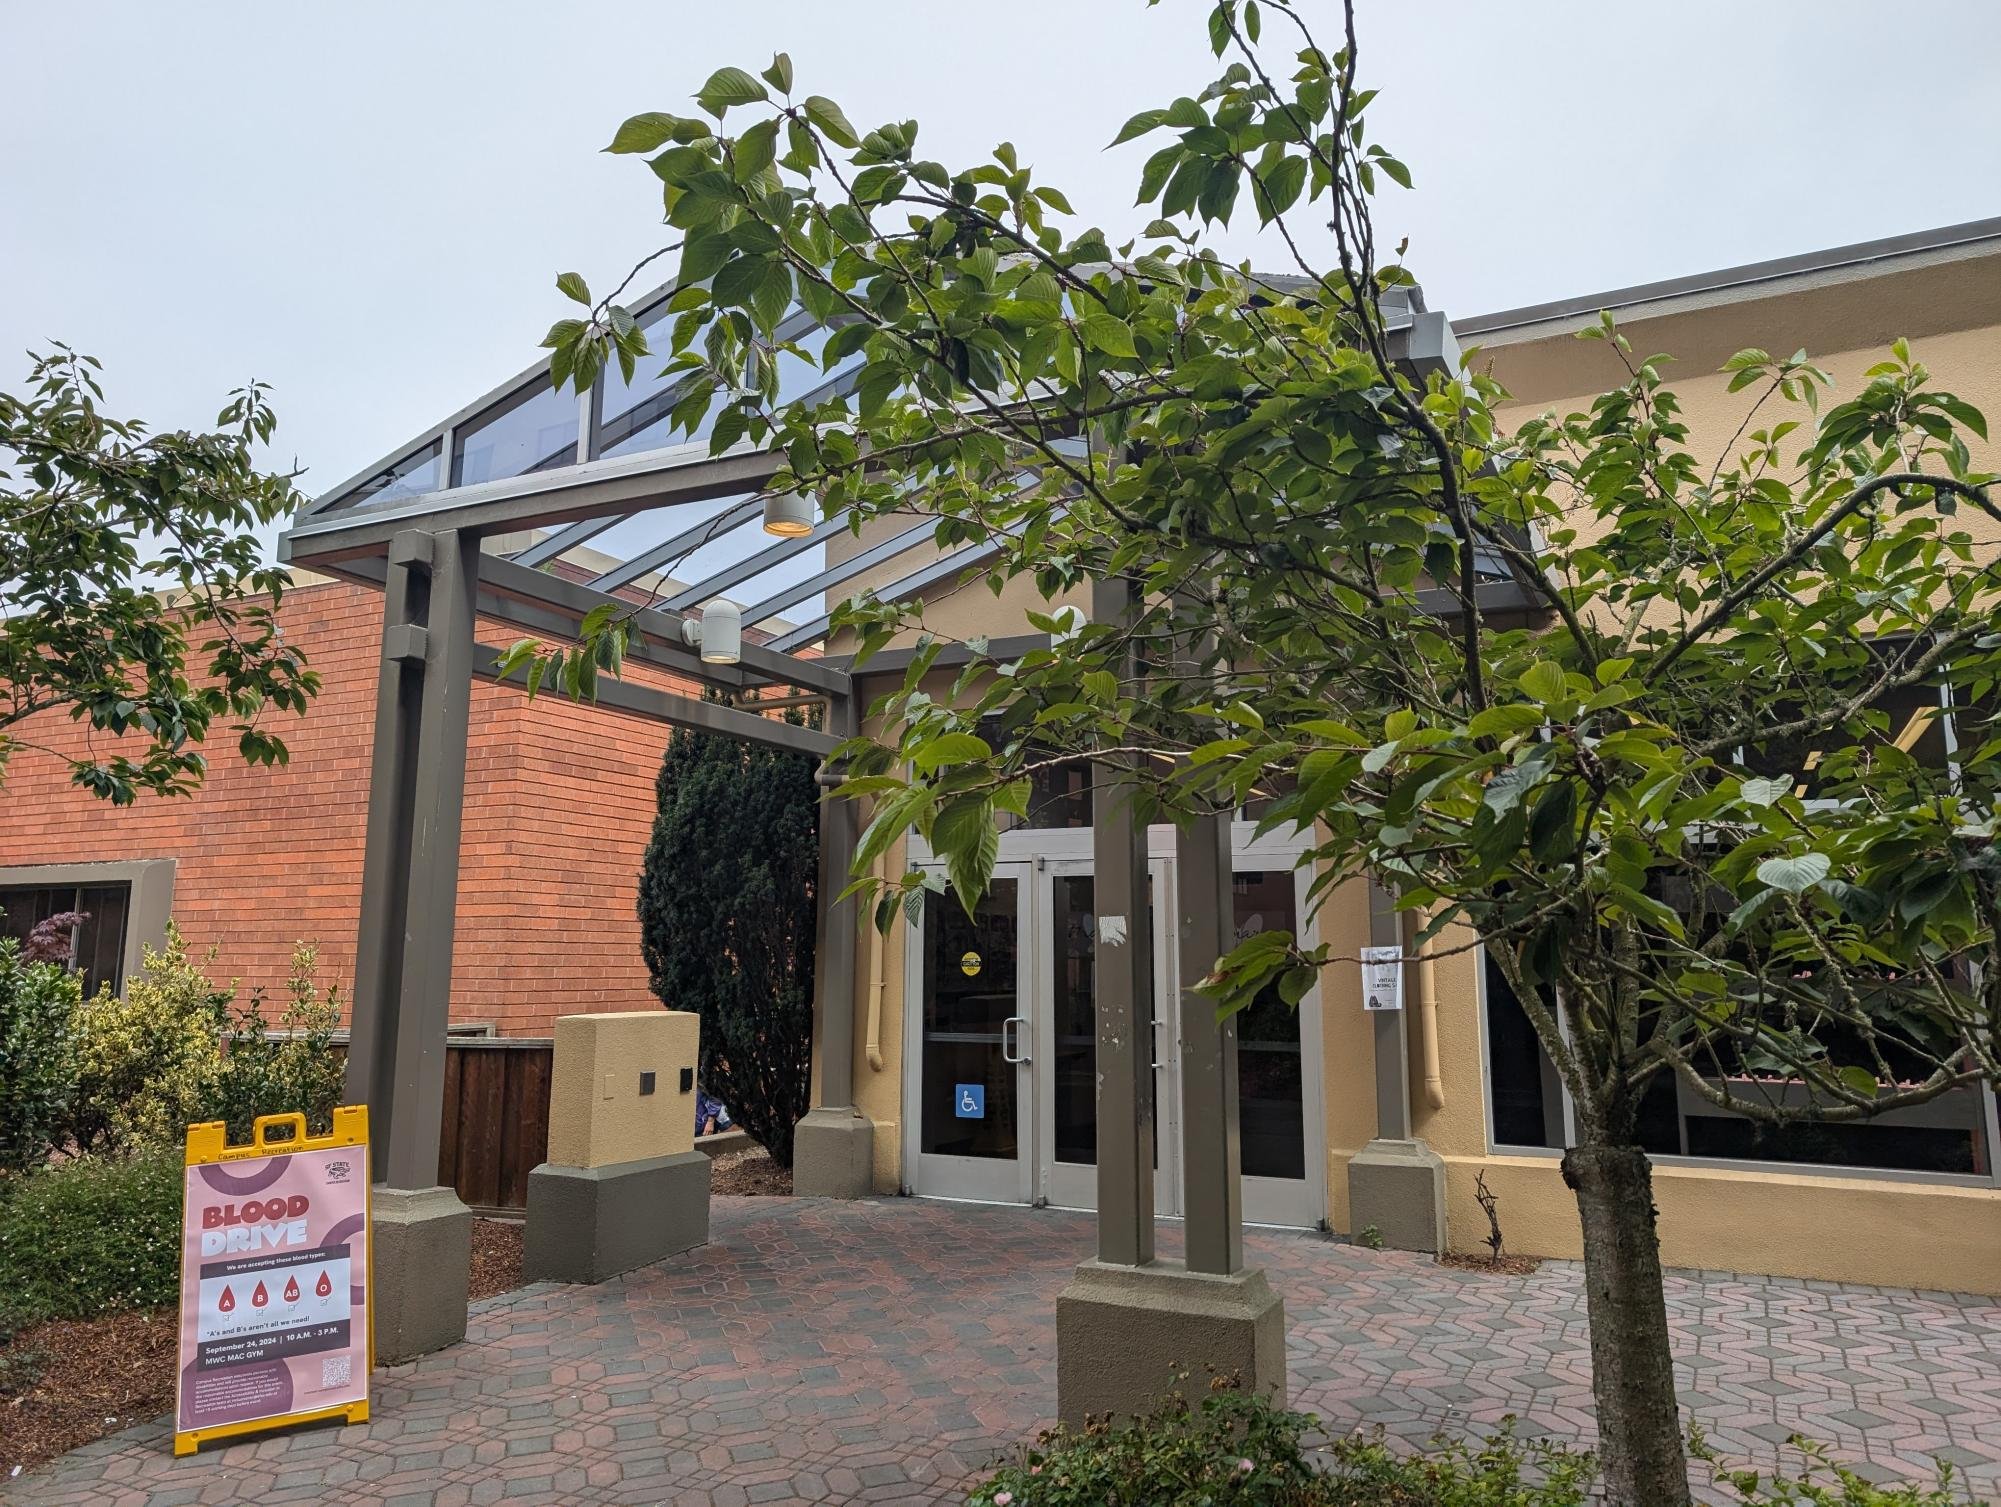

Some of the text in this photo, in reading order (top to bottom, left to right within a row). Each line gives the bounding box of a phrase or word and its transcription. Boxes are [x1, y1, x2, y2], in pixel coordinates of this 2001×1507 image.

[202, 1195, 309, 1229] BLOOD
[201, 1219, 308, 1257] DRIVE
[248, 1259, 275, 1268] accepting
[309, 1252, 326, 1260] types:
[285, 1289, 298, 1298] AB
[320, 1284, 327, 1292] O
[223, 1299, 231, 1307] A
[257, 1294, 264, 1302] B
[248, 1321, 269, 1330] aren't
[291, 1315, 310, 1325] need!
[205, 1342, 245, 1355] September
[246, 1340, 258, 1350] 24,
[259, 1336, 277, 1346] 2024
[295, 1331, 312, 1339] A.M.
[323, 1327, 339, 1335] P.M.
[205, 1350, 264, 1365] MWC MAC GYM
